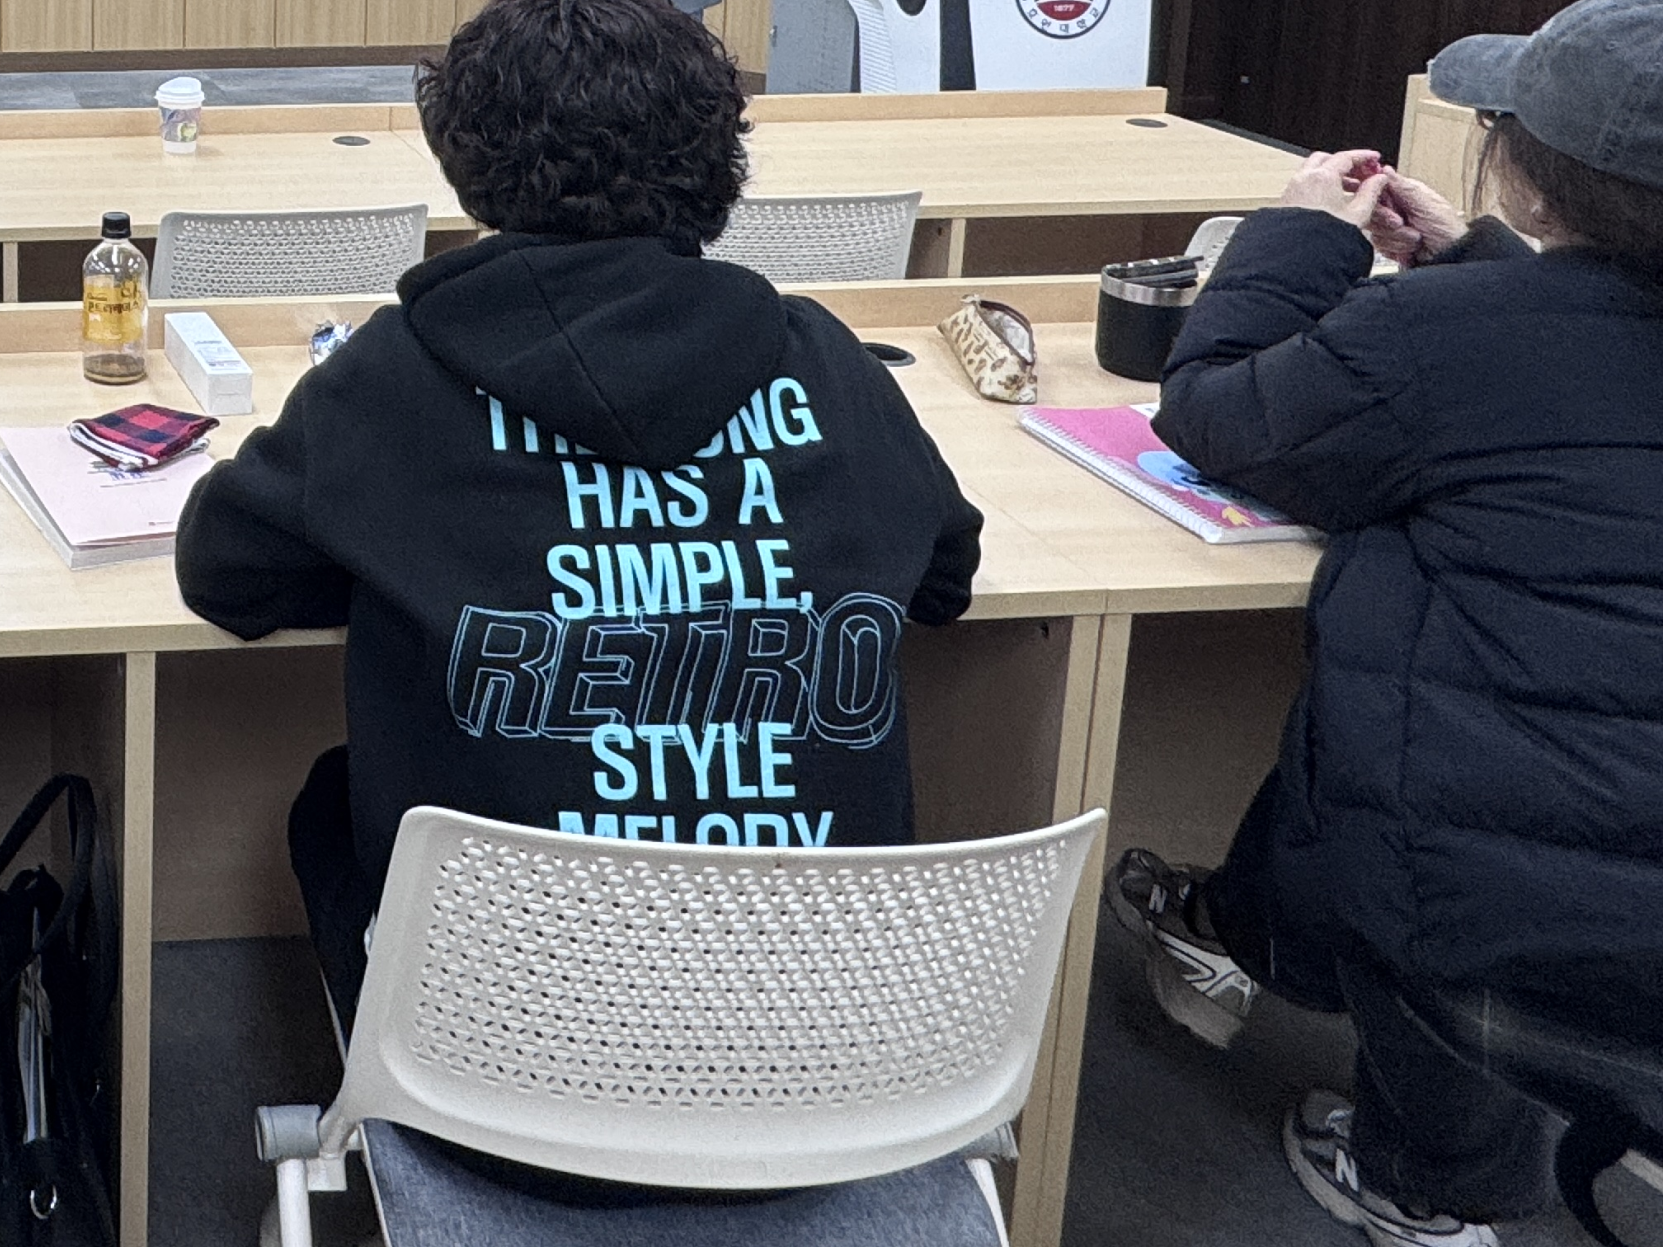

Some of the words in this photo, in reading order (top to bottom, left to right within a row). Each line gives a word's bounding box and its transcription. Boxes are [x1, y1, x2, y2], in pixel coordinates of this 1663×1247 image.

[561, 461, 709, 529] HAS
[738, 457, 783, 525] A
[546, 539, 813, 619] SIMPLE,
[447, 593, 906, 749] RETRO
[591, 722, 796, 801] STYLE
[1335, 1148, 1358, 1192] N
